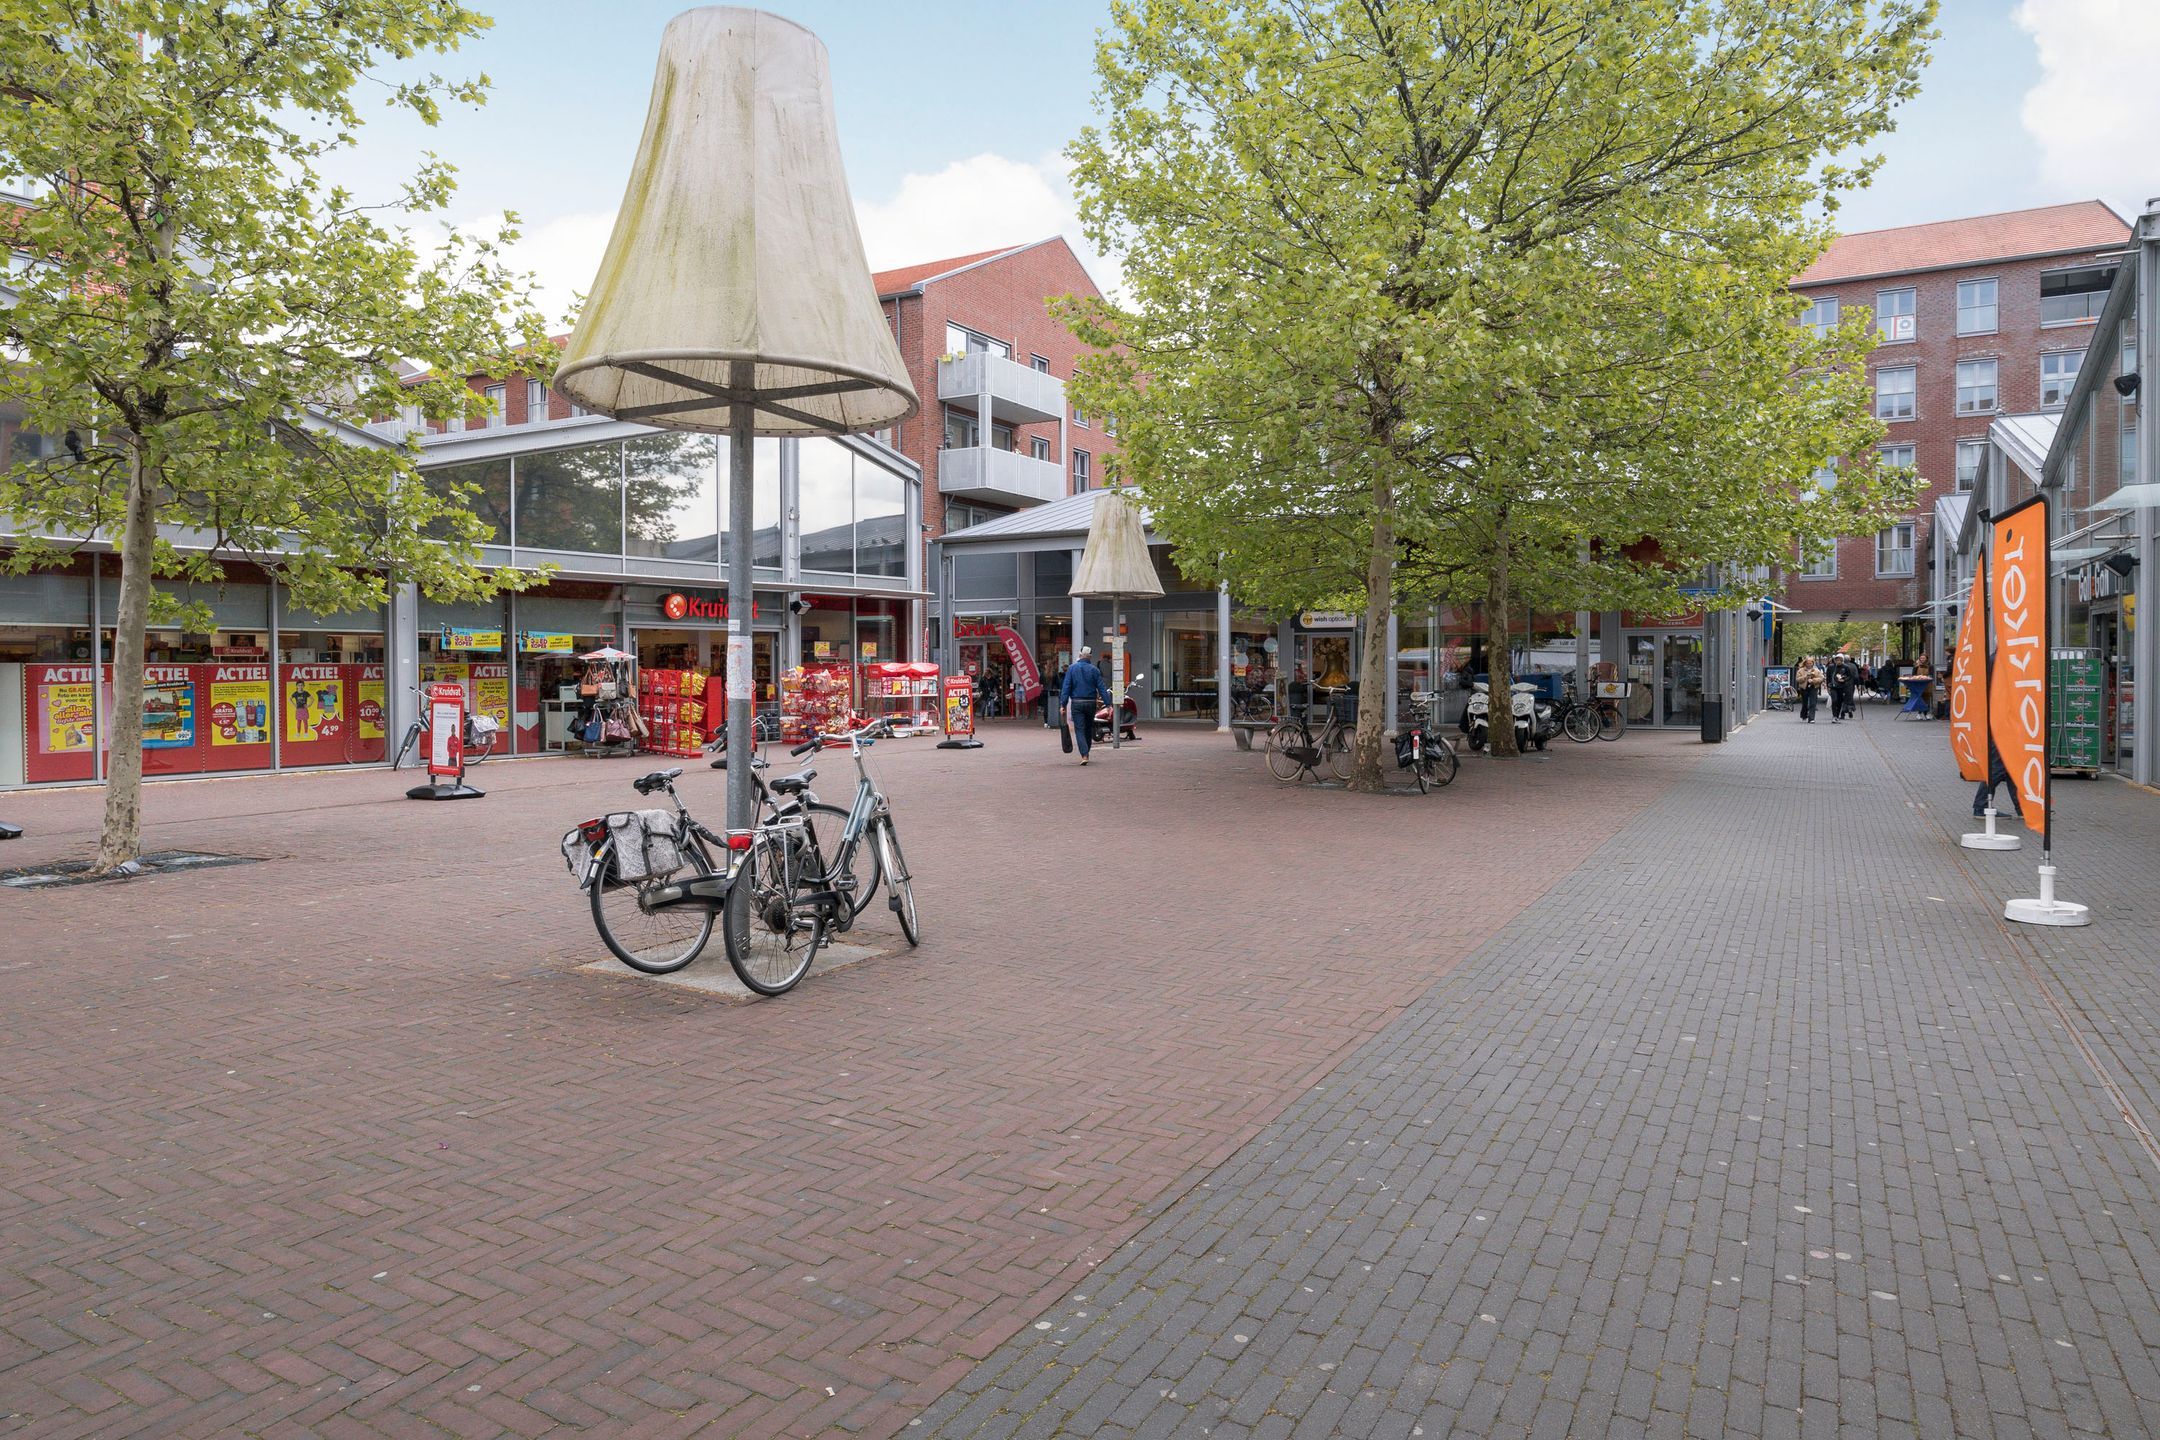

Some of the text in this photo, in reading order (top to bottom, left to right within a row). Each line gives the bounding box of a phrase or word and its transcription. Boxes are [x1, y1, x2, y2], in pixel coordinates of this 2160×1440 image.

[688, 597, 759, 618] Kruit
[955, 617, 1007, 638] brun
[44, 668, 105, 682] ACTI!
[144, 667, 189, 681] CTIE!
[215, 667, 267, 680] ACTIE!
[291, 667, 339, 679] ACTIE!
[439, 687, 461, 696] Kruidvat
[949, 688, 970, 697] ACTIE!
[321, 725, 339, 736] 4.99
